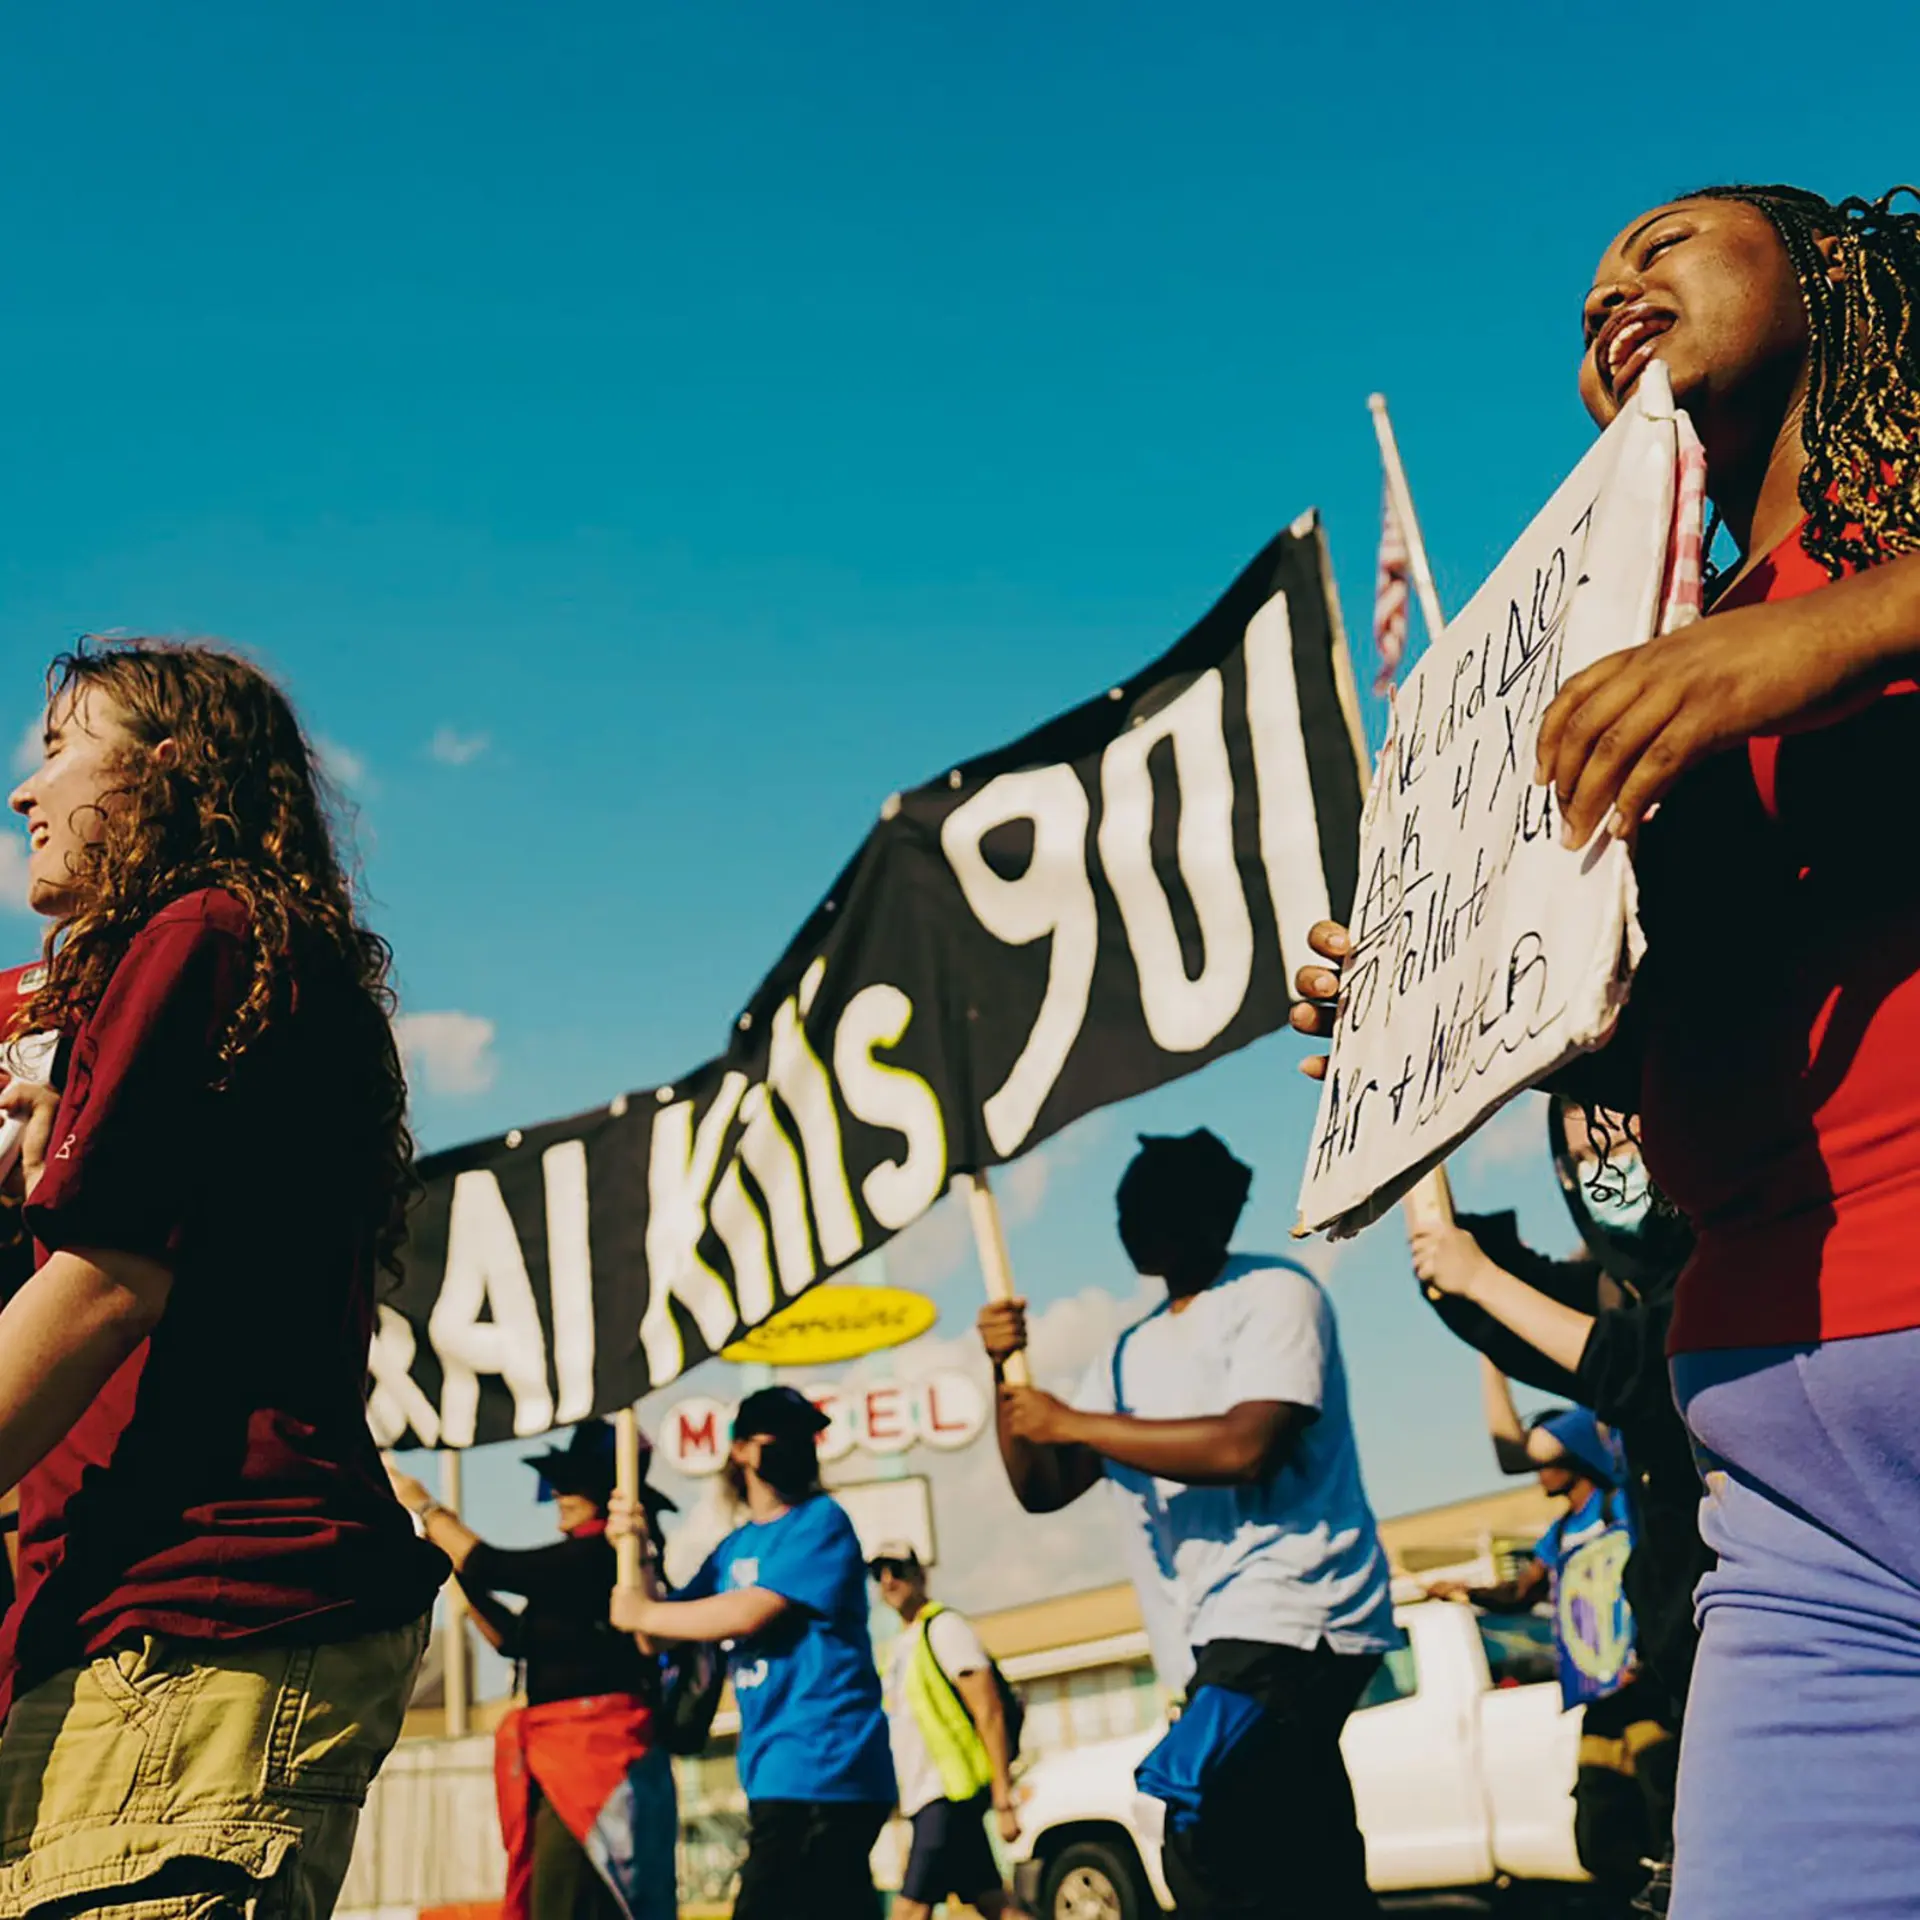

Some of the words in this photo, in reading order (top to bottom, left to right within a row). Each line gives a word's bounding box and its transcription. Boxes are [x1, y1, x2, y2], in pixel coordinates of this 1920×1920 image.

[1435, 630, 1494, 757] did
[1451, 738, 1479, 831] 4
[941, 590, 1339, 1158] 901
[1312, 1067, 1378, 1182] Air
[678, 1384, 968, 1460] MEL
